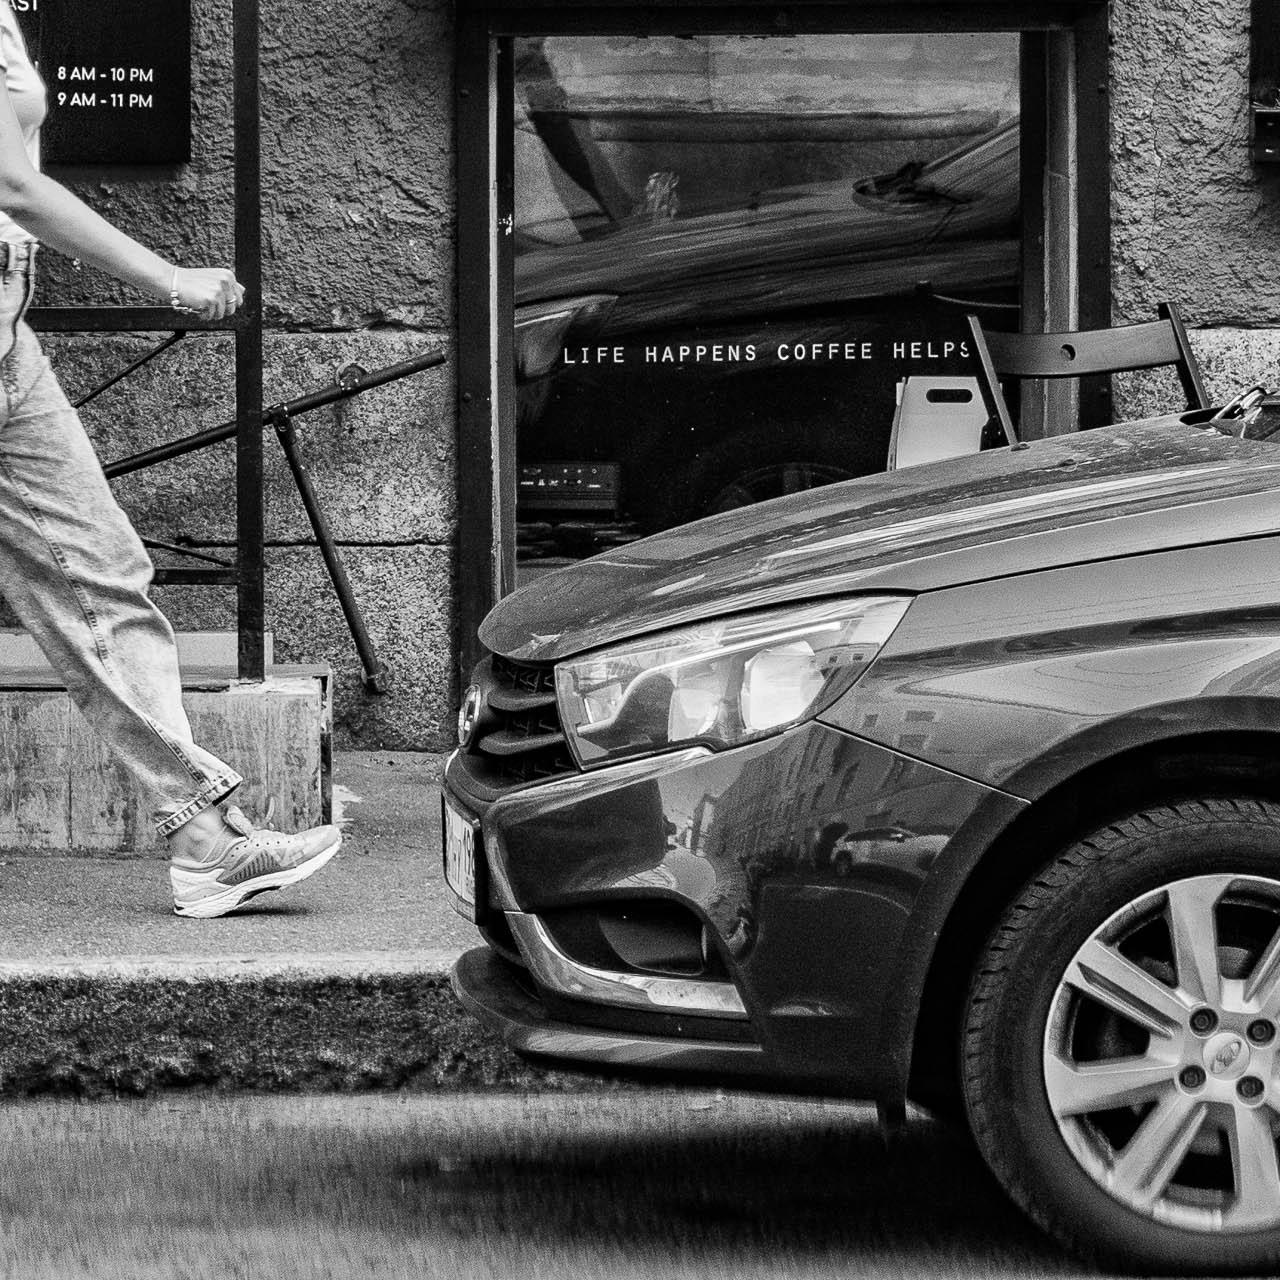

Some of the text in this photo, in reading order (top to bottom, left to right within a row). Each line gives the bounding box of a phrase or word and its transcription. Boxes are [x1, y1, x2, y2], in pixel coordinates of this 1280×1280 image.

[57, 66, 67, 81] 8
[69, 66, 96, 81] AM
[110, 67, 125, 81] 10
[130, 68, 153, 82] PM
[57, 92, 67, 106] 9
[69, 92, 96, 107] AM
[110, 93, 124, 107] 11
[129, 94, 153, 108] PM
[564, 341, 970, 364] LIFE HAPPENS COFFEE HELPS
